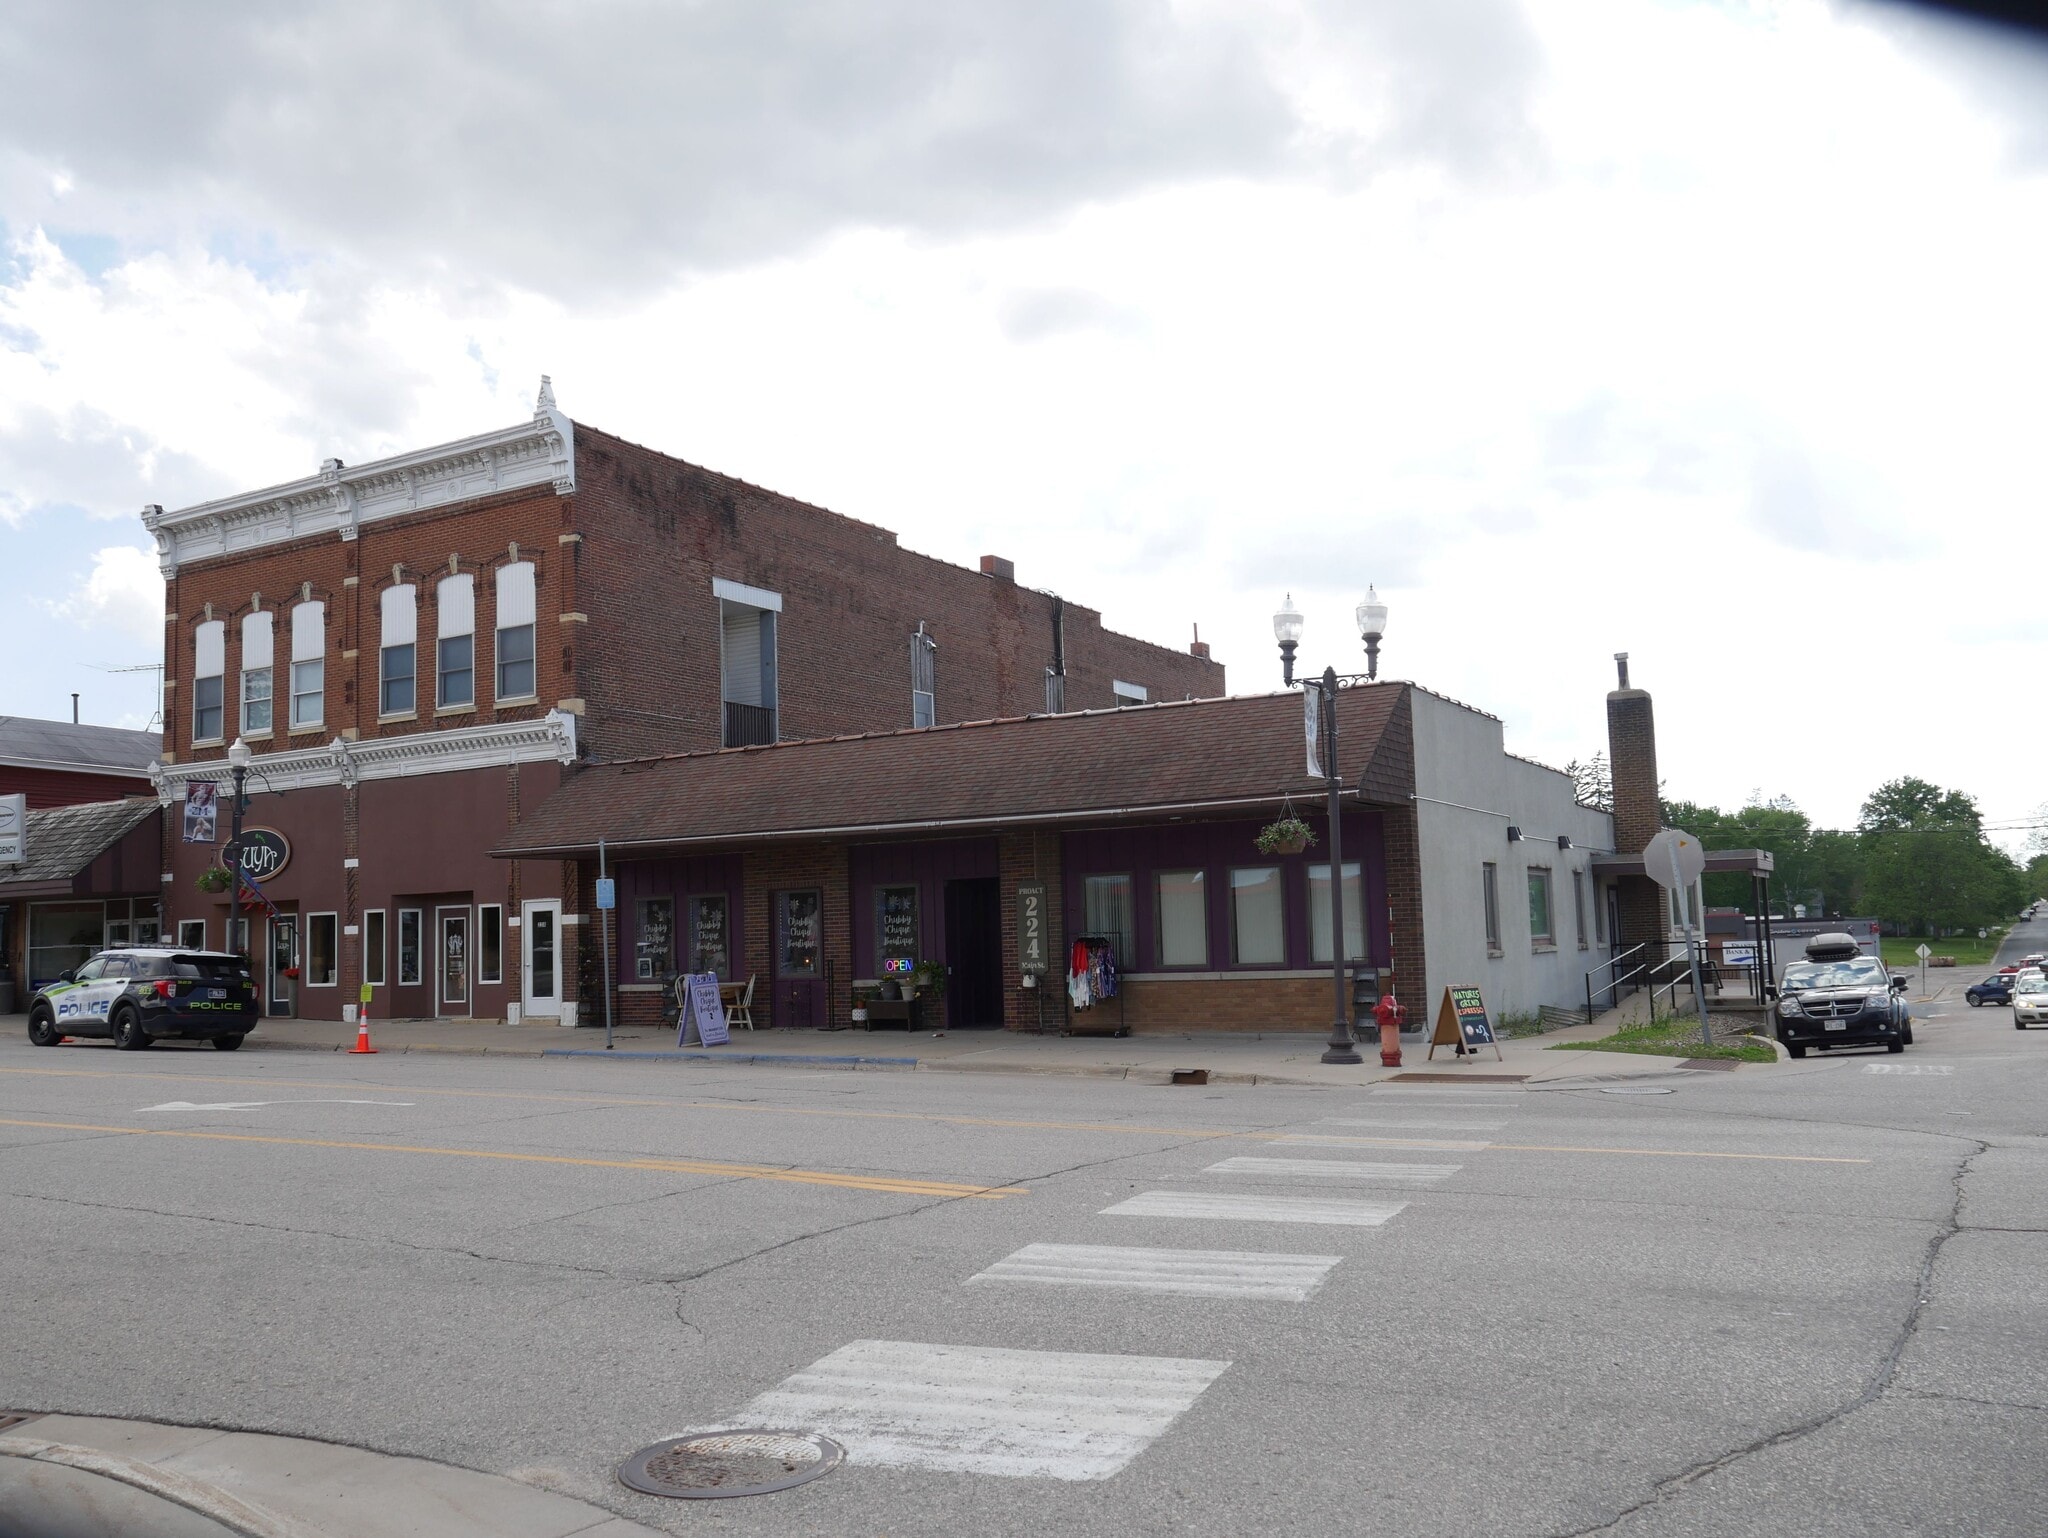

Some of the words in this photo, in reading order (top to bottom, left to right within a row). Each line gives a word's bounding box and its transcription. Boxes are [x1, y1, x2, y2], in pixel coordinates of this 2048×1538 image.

[1019, 887, 1043, 895] PROACT
[1025, 896, 1040, 959] 224
[886, 960, 912, 971] OPEN
[59, 1000, 109, 1016] POLICE
[190, 1002, 242, 1010] POLICE
